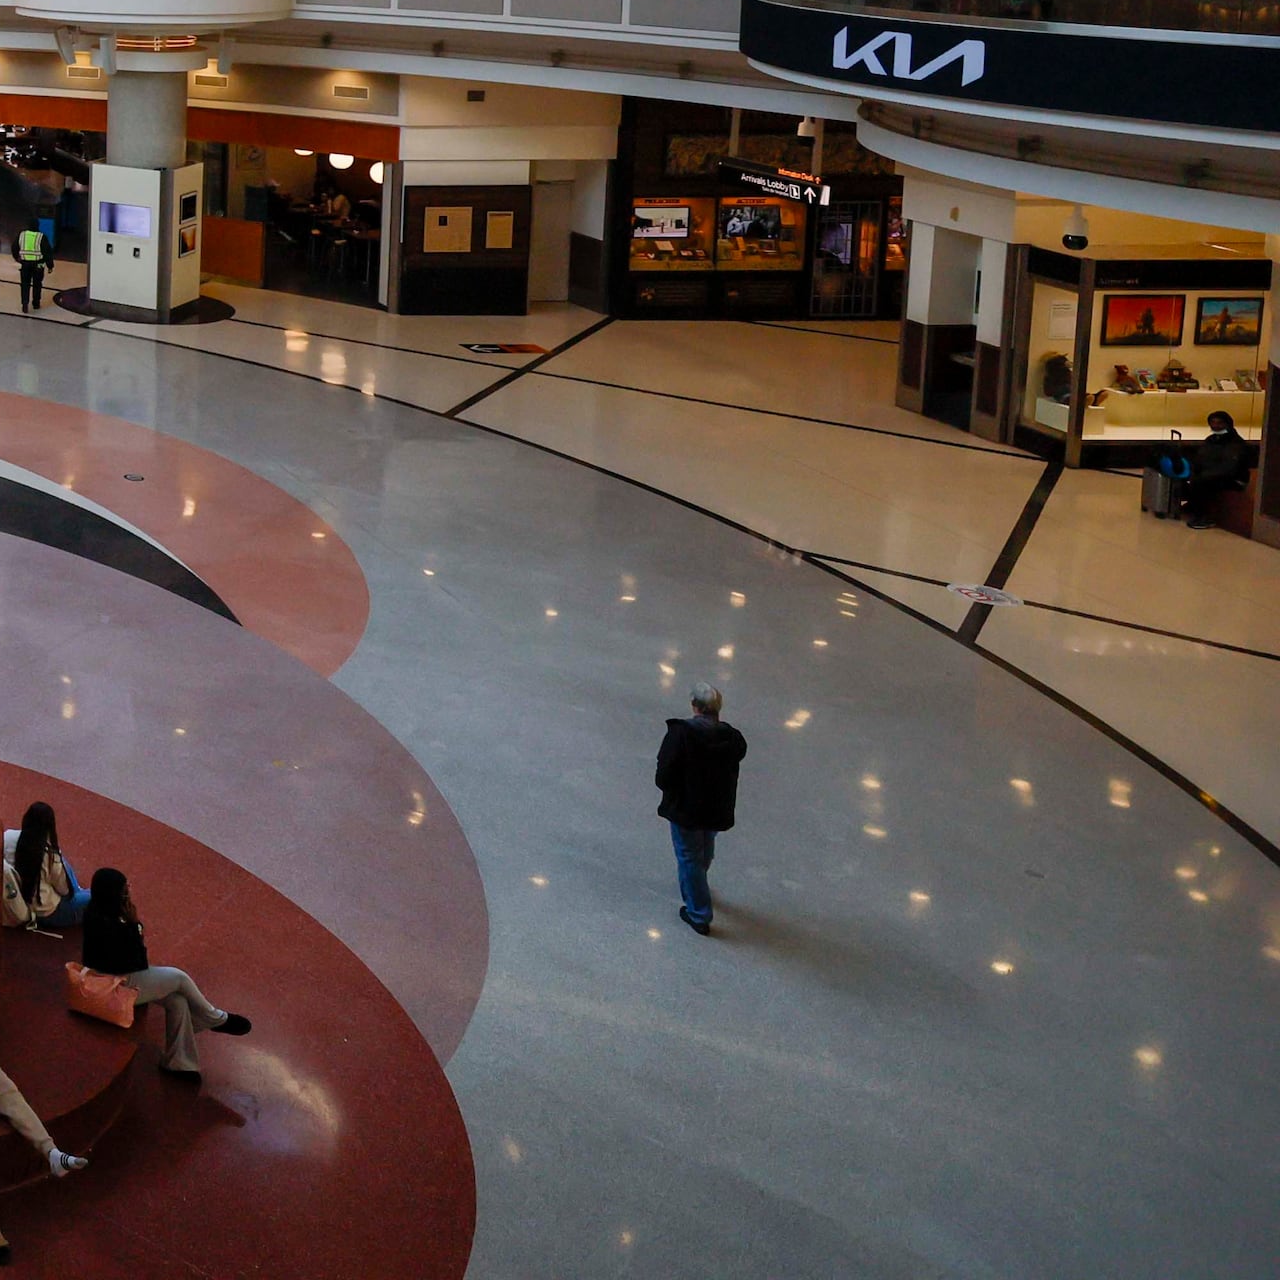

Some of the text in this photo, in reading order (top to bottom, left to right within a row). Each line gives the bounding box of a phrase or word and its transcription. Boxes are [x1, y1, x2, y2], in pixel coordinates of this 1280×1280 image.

[832, 25, 986, 88] KIA
[740, 172, 790, 193] Arrivals Lobby
